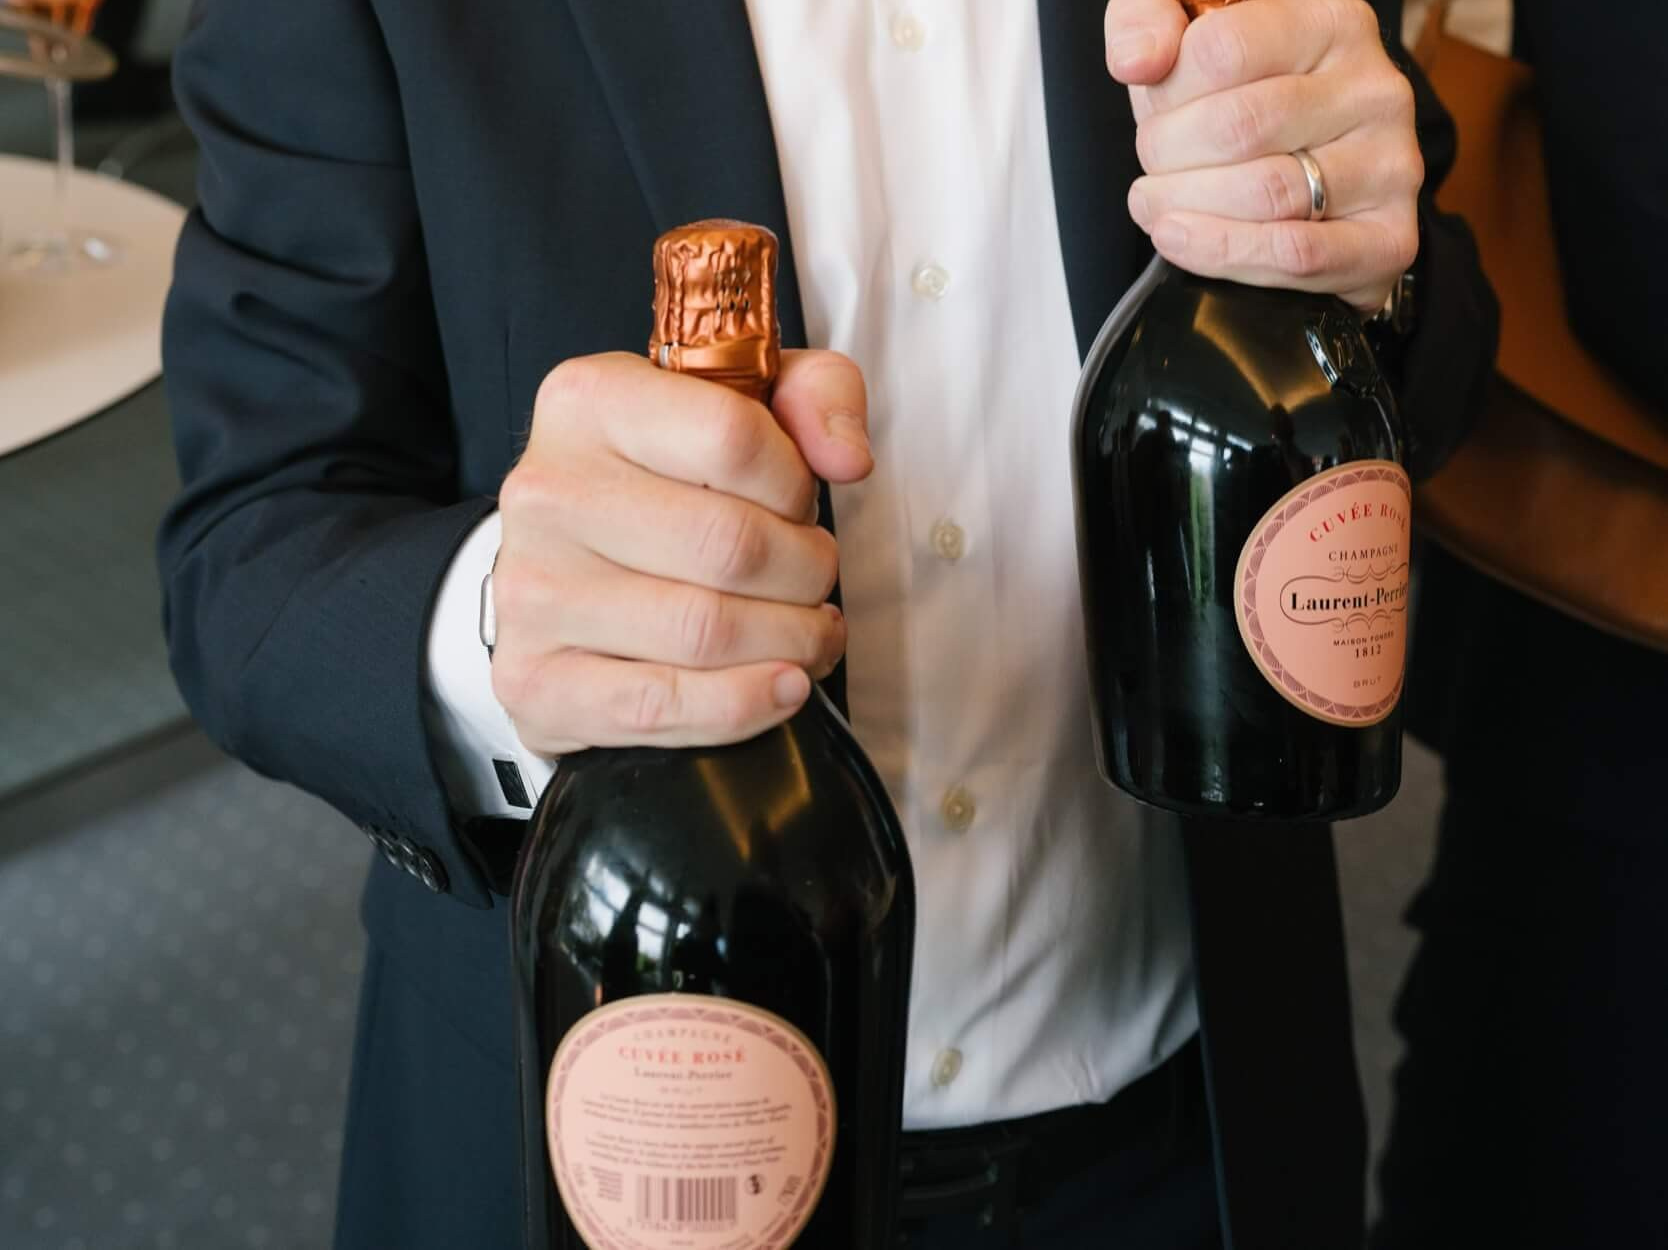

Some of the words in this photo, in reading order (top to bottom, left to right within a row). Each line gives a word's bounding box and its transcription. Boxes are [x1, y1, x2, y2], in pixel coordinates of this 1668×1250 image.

[1309, 502, 1372, 542] CUVÉE
[1328, 544, 1398, 561] CHAMPAGNE
[1291, 582, 1407, 611] Laurent-Perrie
[1333, 638, 1367, 646] MAISON
[1356, 644, 1381, 658] 1812
[1353, 675, 1381, 688] BRUT
